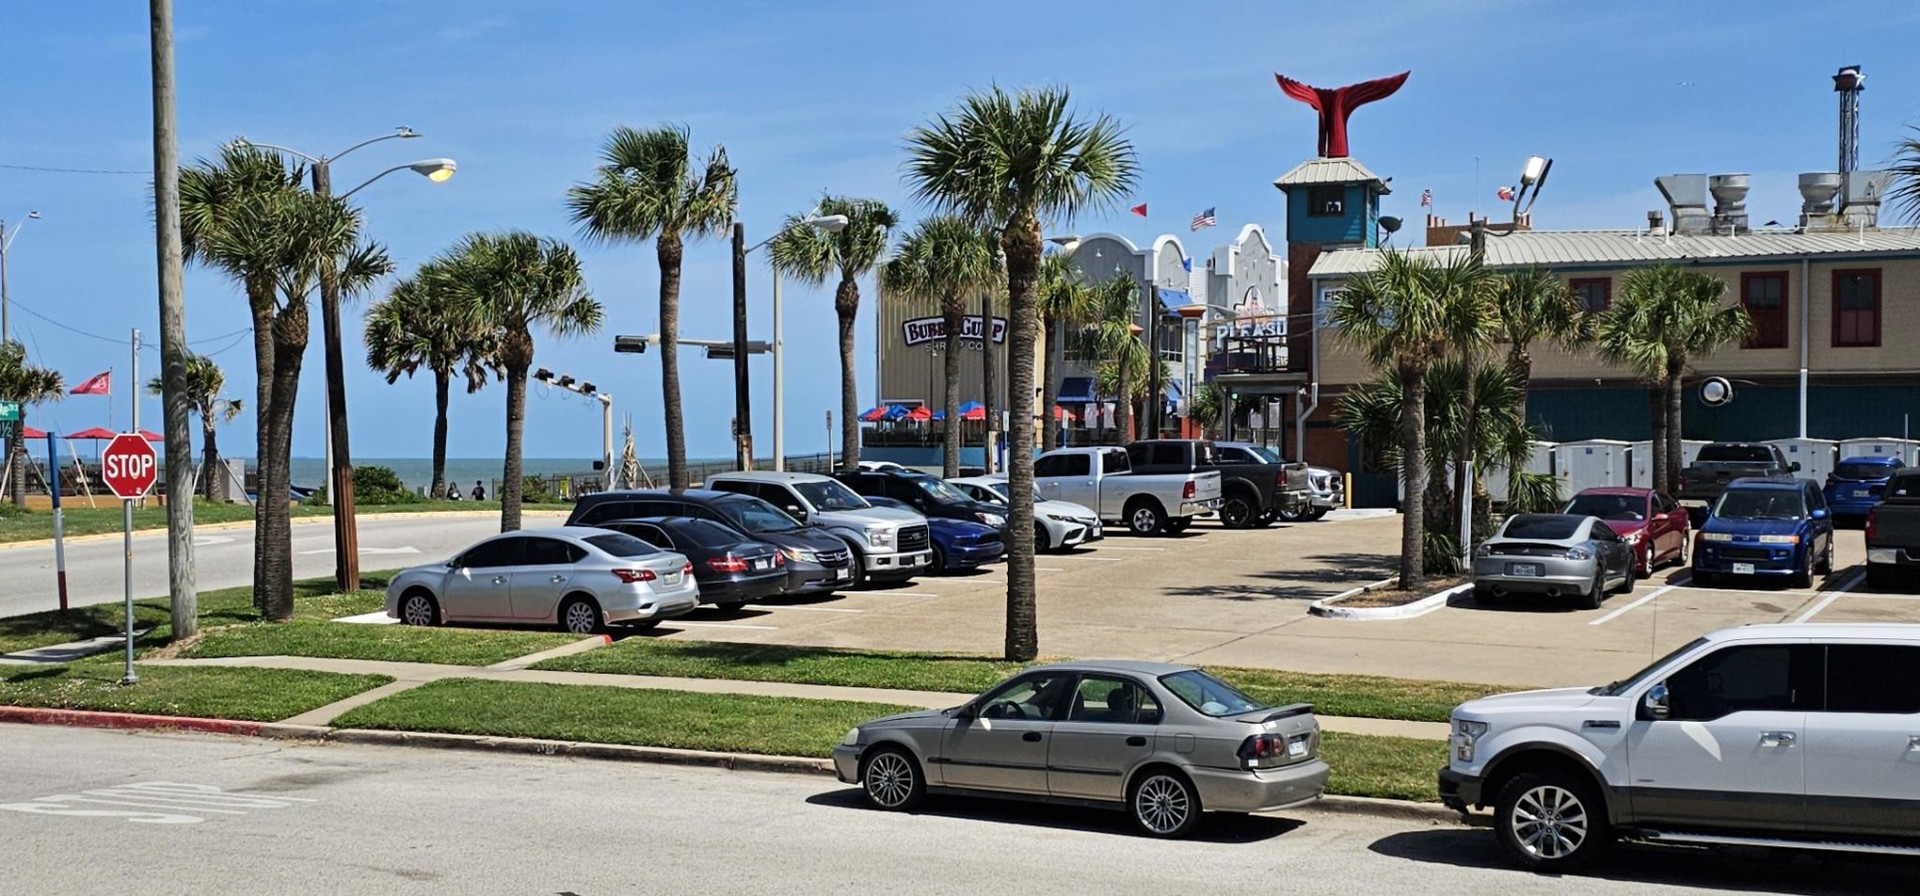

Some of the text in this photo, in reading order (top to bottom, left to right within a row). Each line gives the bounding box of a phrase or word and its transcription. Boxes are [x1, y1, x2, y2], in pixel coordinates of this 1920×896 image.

[908, 318, 1003, 341] BUBB GUP
[107, 454, 154, 479] STOP
